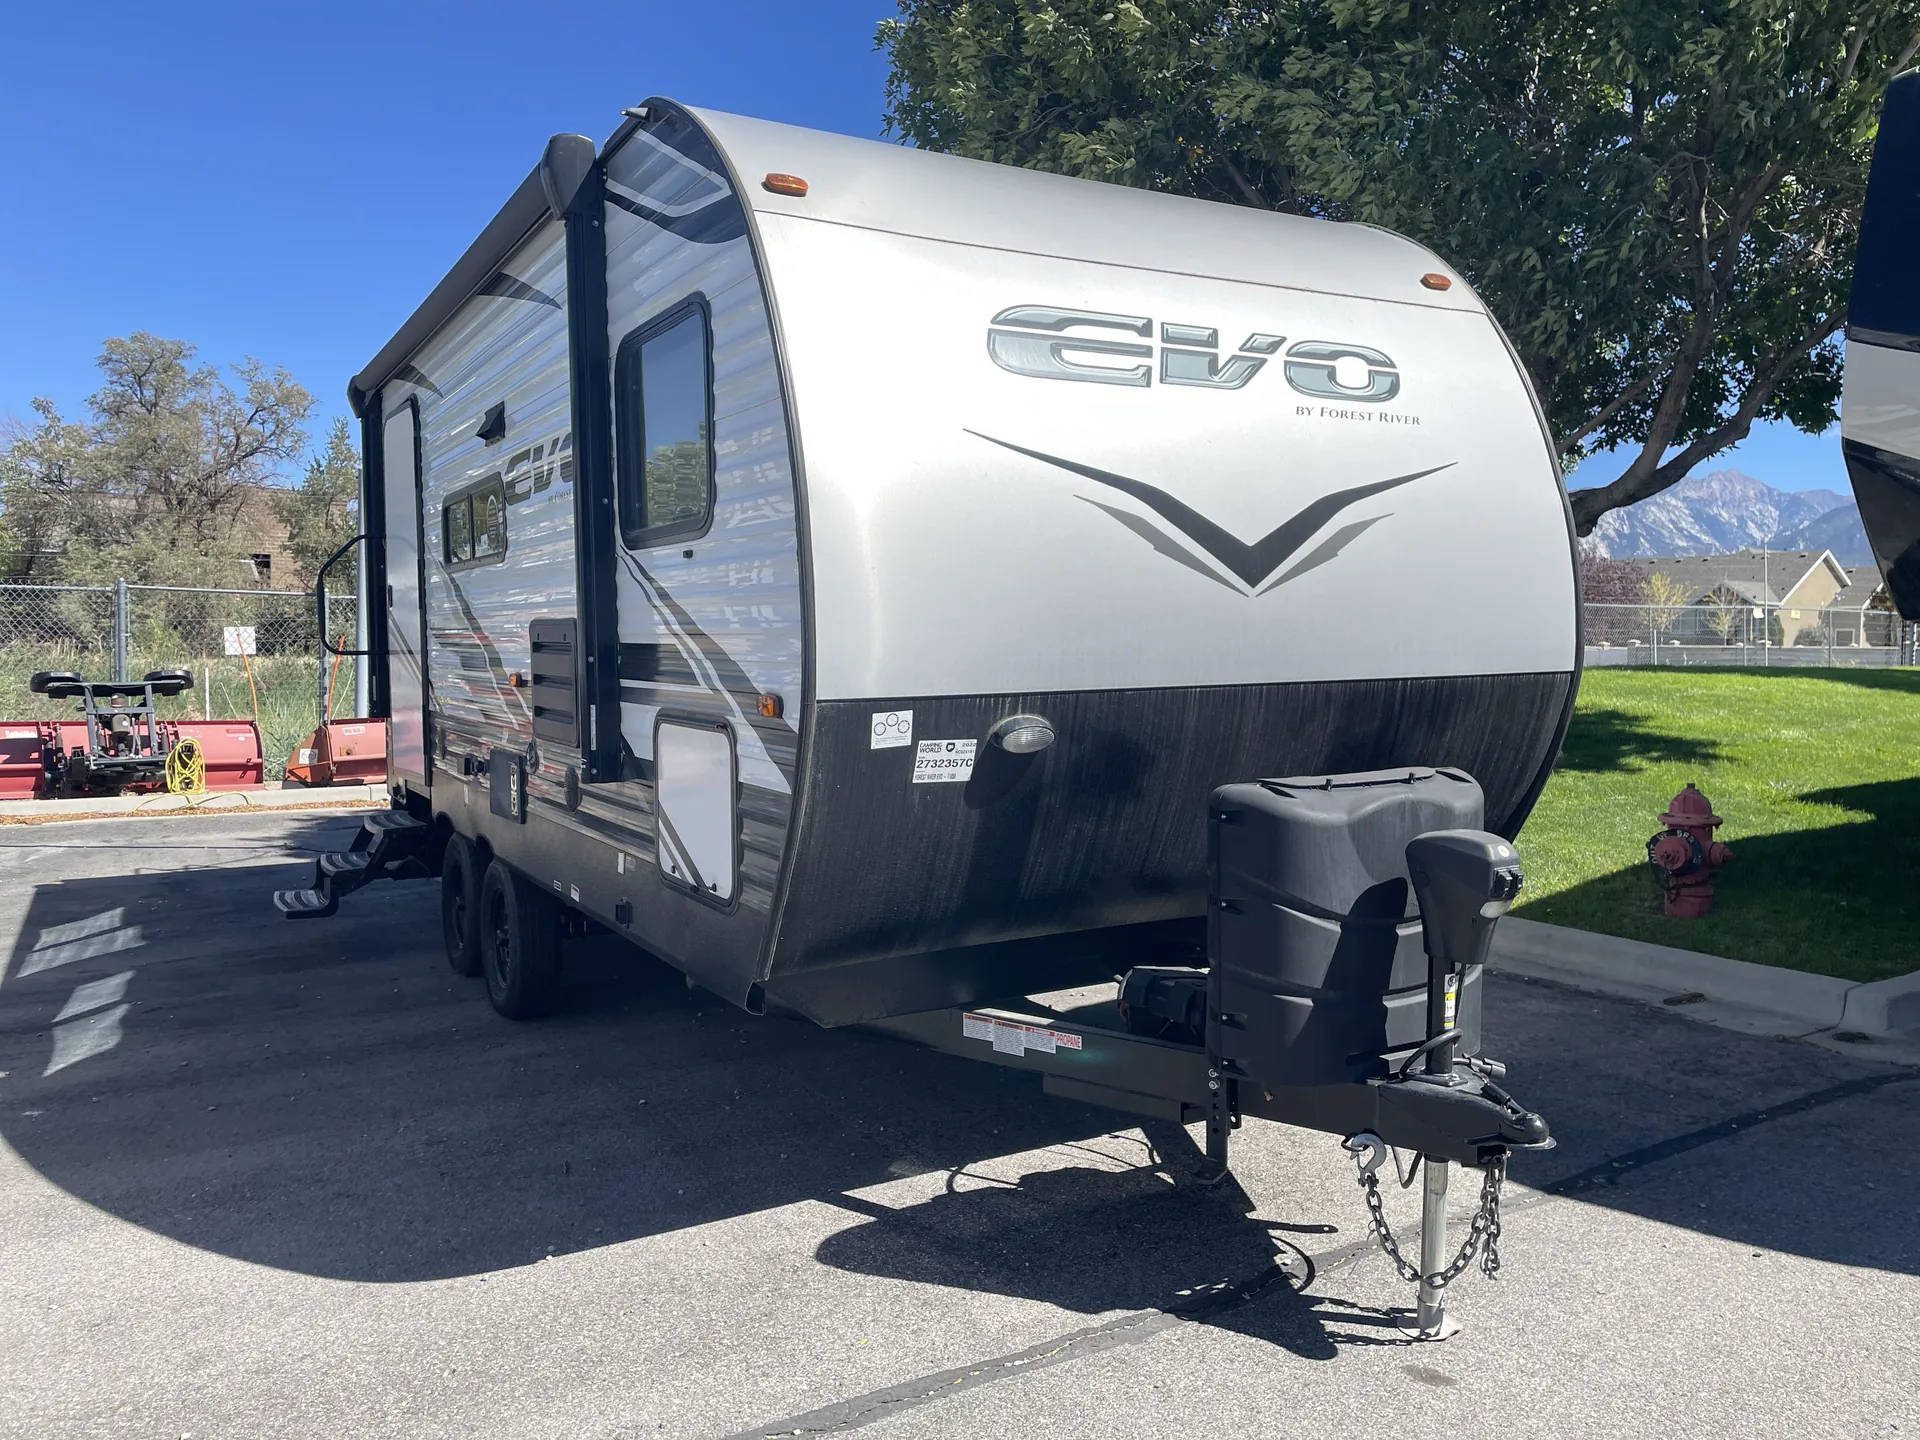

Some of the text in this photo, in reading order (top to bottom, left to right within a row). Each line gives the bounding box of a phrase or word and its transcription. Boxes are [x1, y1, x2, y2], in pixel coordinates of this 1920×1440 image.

[986, 303, 1401, 404] EVO
[1296, 406, 1421, 425] BY FOREST RIVER
[916, 758, 973, 768] 2732357C
[1056, 1033, 1081, 1048] PROPANE
